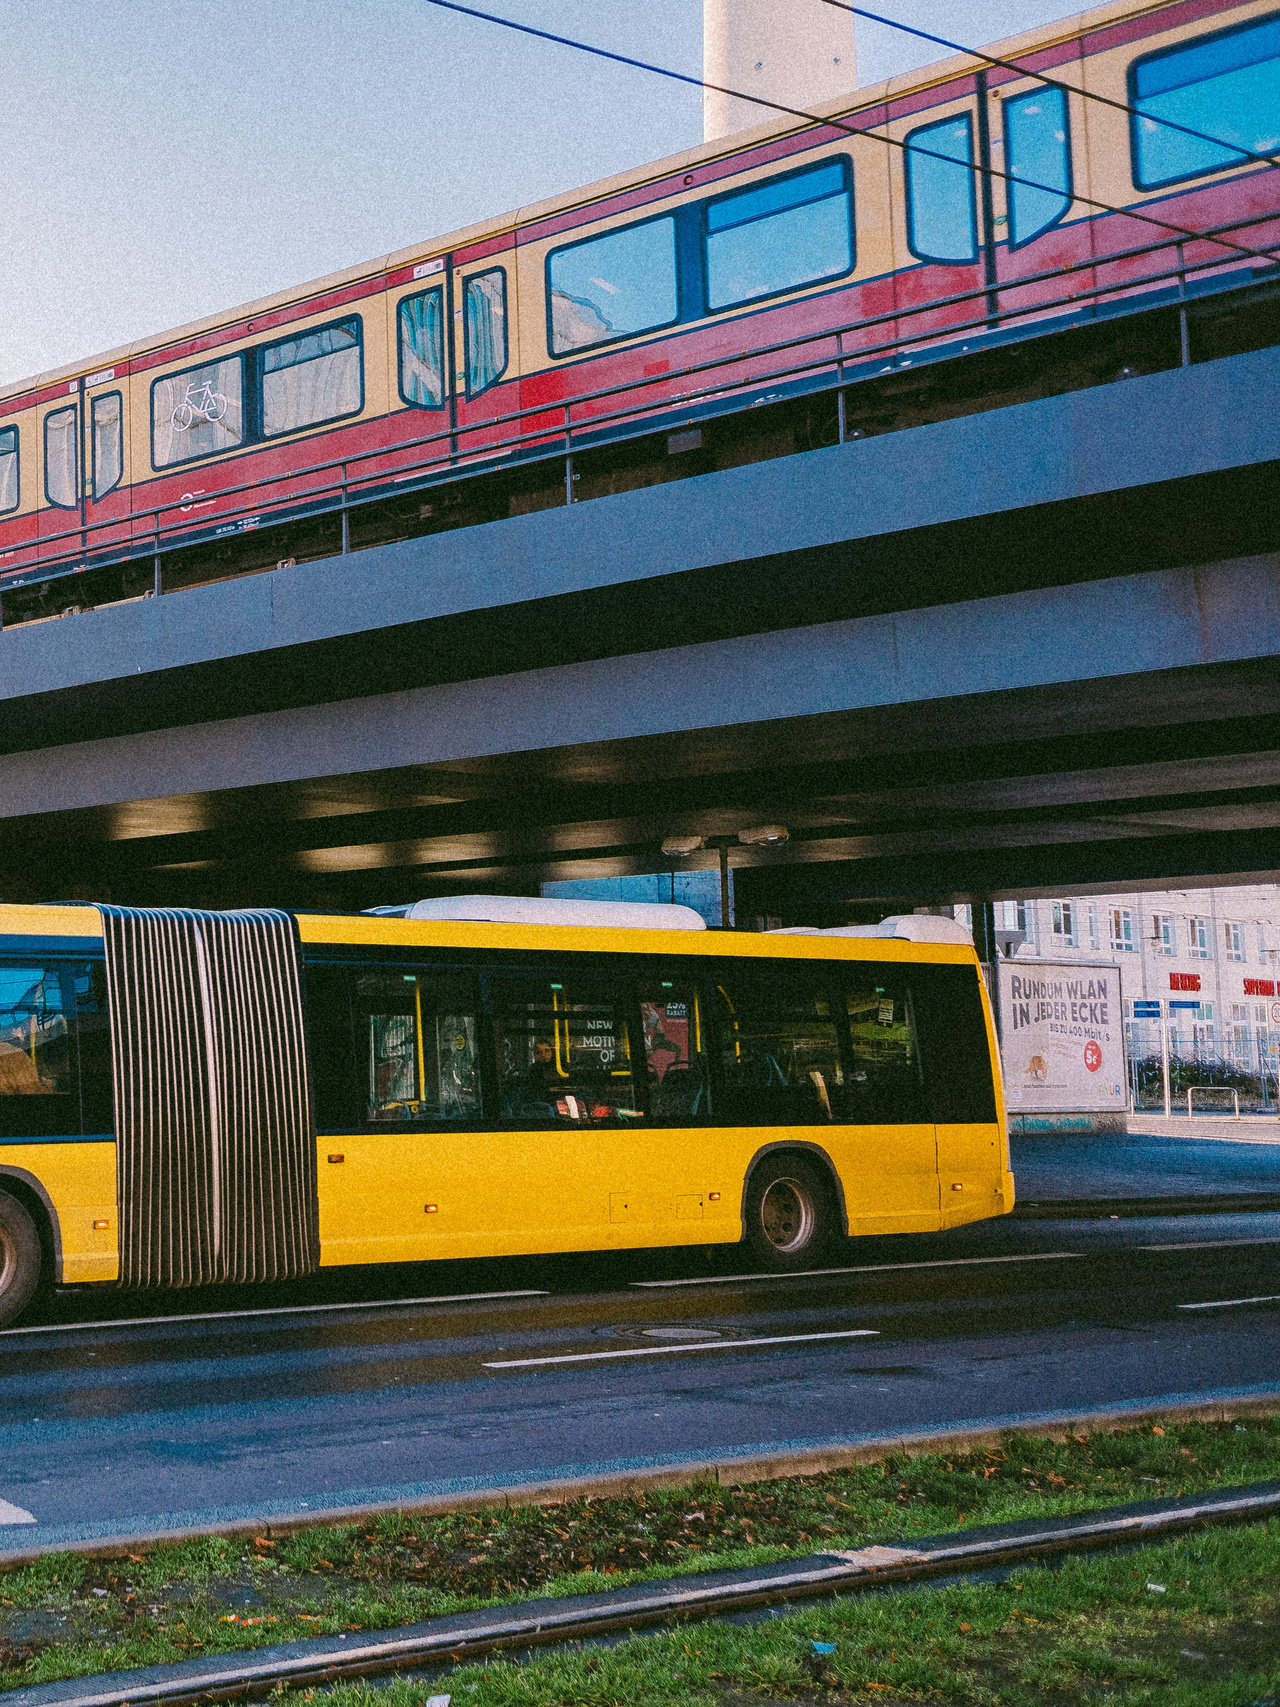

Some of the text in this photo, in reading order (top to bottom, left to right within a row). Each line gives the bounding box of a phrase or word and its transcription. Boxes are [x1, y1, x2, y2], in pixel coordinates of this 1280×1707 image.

[1011, 975, 1108, 999] RUNDUM WLAN
[1012, 1001, 1109, 1029] IN JEDER ECKE
[1069, 1026, 1082, 1037] 400
